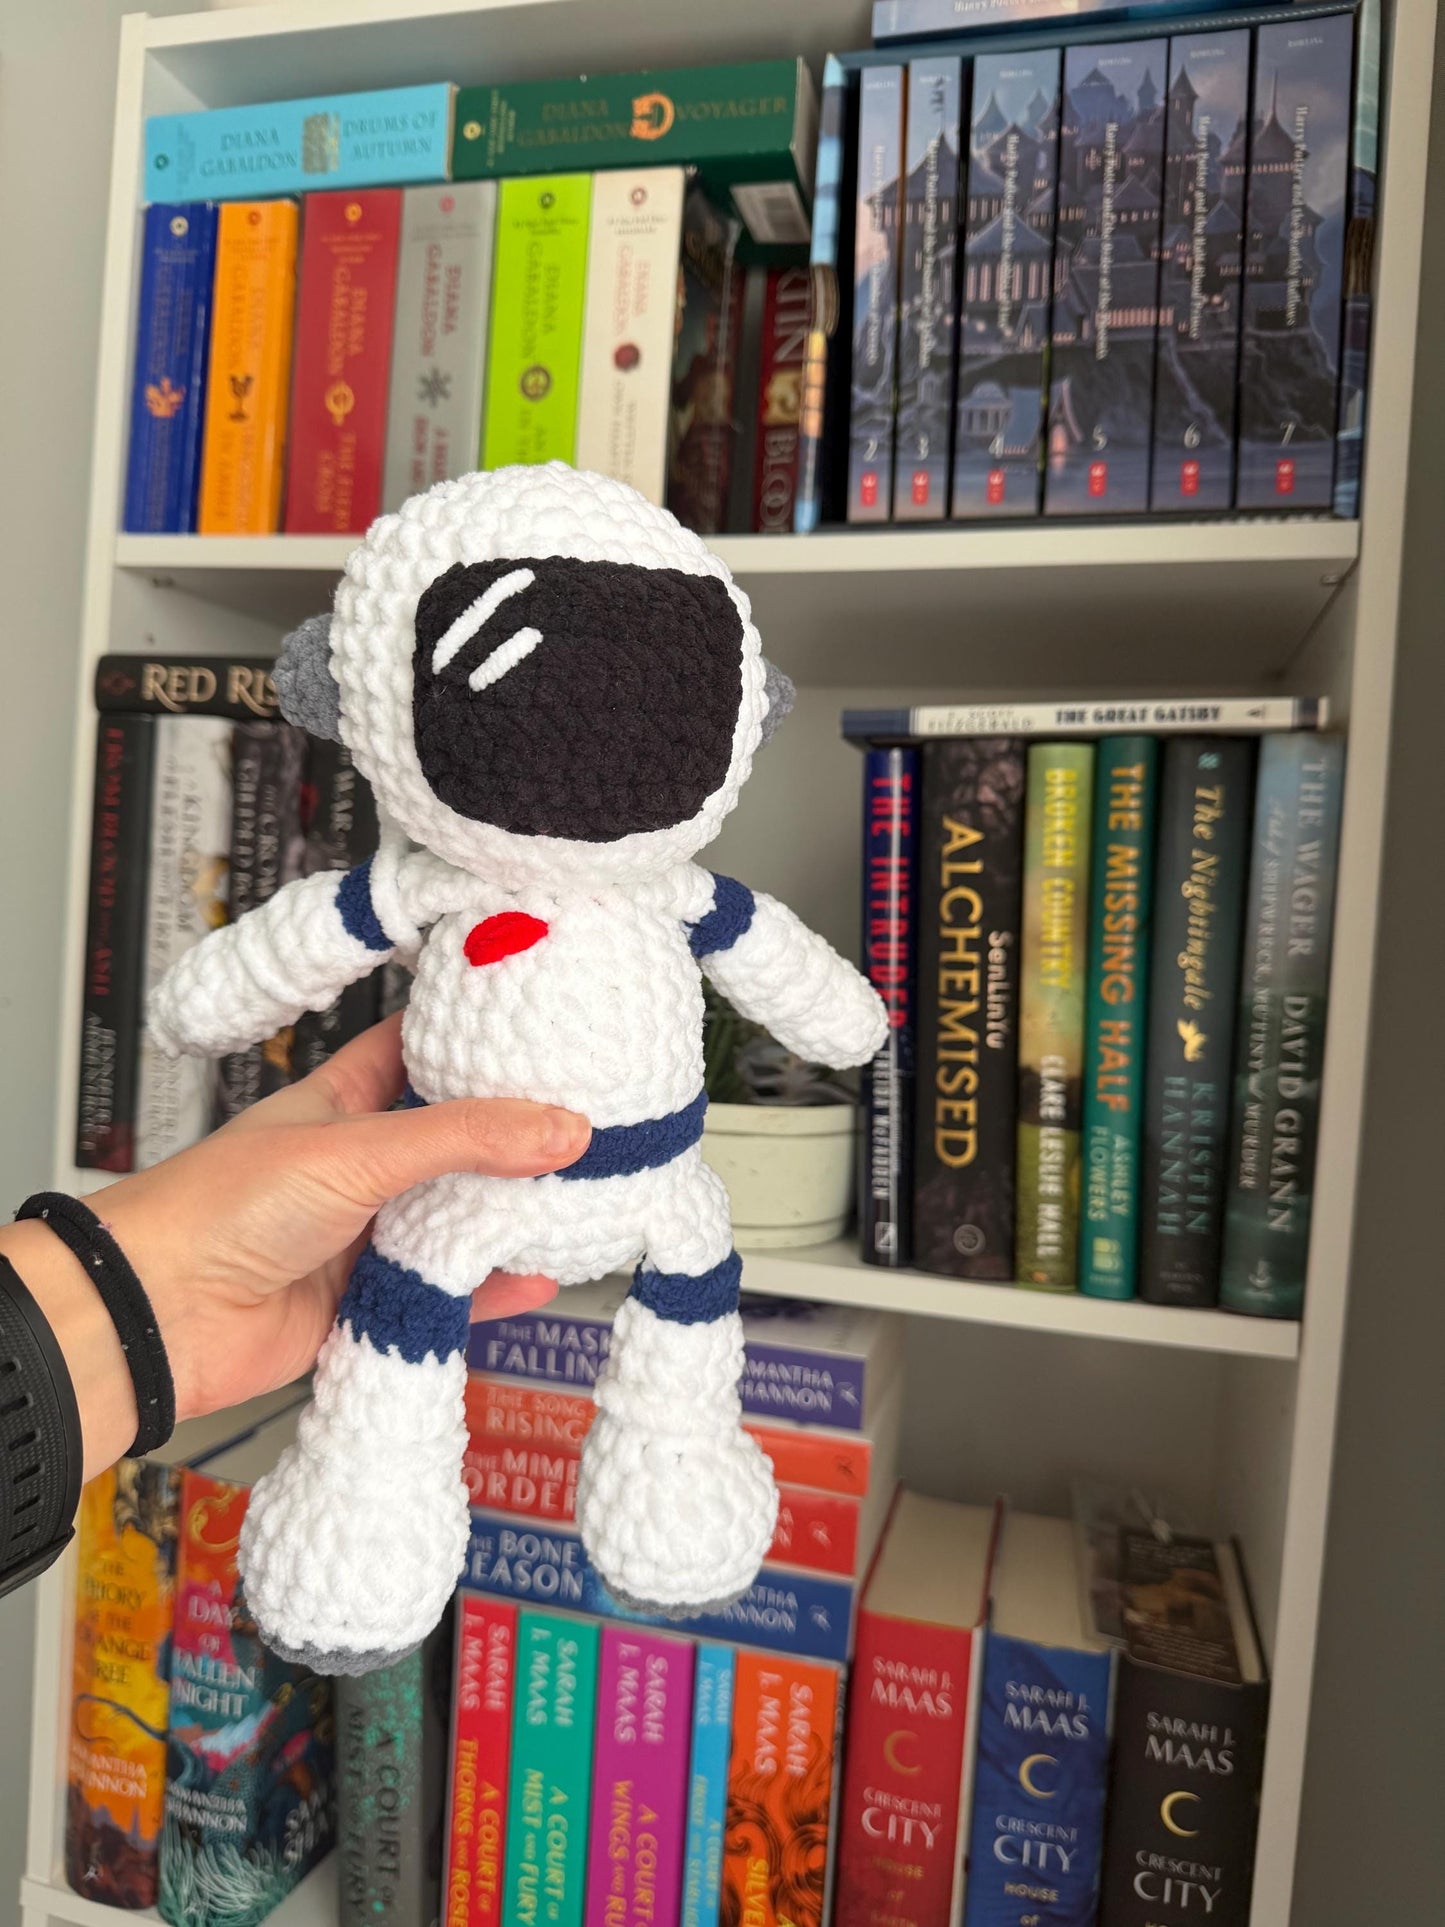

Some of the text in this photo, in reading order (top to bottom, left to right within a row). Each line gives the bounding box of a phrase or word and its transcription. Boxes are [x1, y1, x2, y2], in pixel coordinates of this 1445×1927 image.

[675, 96, 788, 121] VOYAGER
[1093, 423, 1107, 450] 5
[1184, 421, 1200, 449] 6
[1280, 421, 1296, 449] 7
[141, 663, 279, 717] RED RIS
[1054, 704, 1222, 725] THE GREAT GATSBY
[871, 772, 912, 836] THE
[1040, 767, 1078, 988] BROKEN COUNTRY
[1287, 758, 1326, 958] THE WAGER
[1177, 785, 1226, 1011] The Nightingale
[1097, 763, 1145, 1113] THE MISSING HALF
[935, 815, 985, 1168] ALCHEMISED
[986, 930, 1013, 1049] SenLinYu
[1267, 995, 1311, 1234] DAVID GRANN
[1036, 1054, 1067, 1259] CLARE LESLIE HALL
[1087, 1125, 1111, 1221] FLOWERS
[1111, 1133, 1134, 1216] ASHLEY
[1157, 1076, 1188, 1236] HANNAH
[1185, 1081, 1217, 1236] KRISTIN
[498, 1322, 532, 1343] THE
[738, 1378, 832, 1413] HANNON
[743, 1359, 834, 1392] MANTHA
[533, 1394, 586, 1419] SONG
[463, 1551, 584, 1602] EASON
[471, 1530, 581, 1569] HE BONE
[208, 1579, 222, 1596] A
[722, 1602, 797, 1634] ANNON
[172, 1646, 257, 1690] FALLEN
[460, 1635, 483, 1711] MAAS
[485, 1622, 510, 1712] SARAH
[526, 1650, 551, 1727] MAAS
[555, 1637, 580, 1728] SARAH
[871, 1655, 937, 1687] SARAH
[172, 1677, 249, 1717] NIGHT
[613, 1664, 640, 1746] MAAS
[641, 1652, 669, 1746] SARAH
[870, 1677, 954, 1720] MAAS
[1004, 1680, 1073, 1709] SARAH
[1004, 1702, 1090, 1740] MAAS
[754, 1695, 781, 1776] MAAS
[785, 1681, 814, 1777] SARAH
[1146, 1711, 1219, 1744] SARAH
[1145, 1734, 1235, 1776] MAAS
[455, 1738, 479, 1835] THORNS
[480, 1780, 500, 1799] A
[522, 1767, 545, 1829] MIST
[550, 1785, 569, 1804] A
[863, 1785, 942, 1818] CRESCENT
[376, 1765, 402, 1880] COURT
[608, 1780, 634, 1862] WINGS
[861, 1806, 942, 1849] CITY
[995, 1814, 1078, 1842] CRESCENT
[477, 1808, 500, 1892] COURT
[544, 1813, 569, 1900] COURT
[632, 1803, 660, 1922] A COURT
[993, 1834, 1078, 1873] CITY
[1135, 1850, 1223, 1881] CRESCENT
[449, 1868, 472, 1927] ROSE
[516, 1862, 541, 1926] FURY
[604, 1894, 628, 1927] RU
[744, 1857, 769, 1927] SILVE
[1003, 1881, 1059, 1903] HOUSE
[1133, 1870, 1223, 1914] CITY
